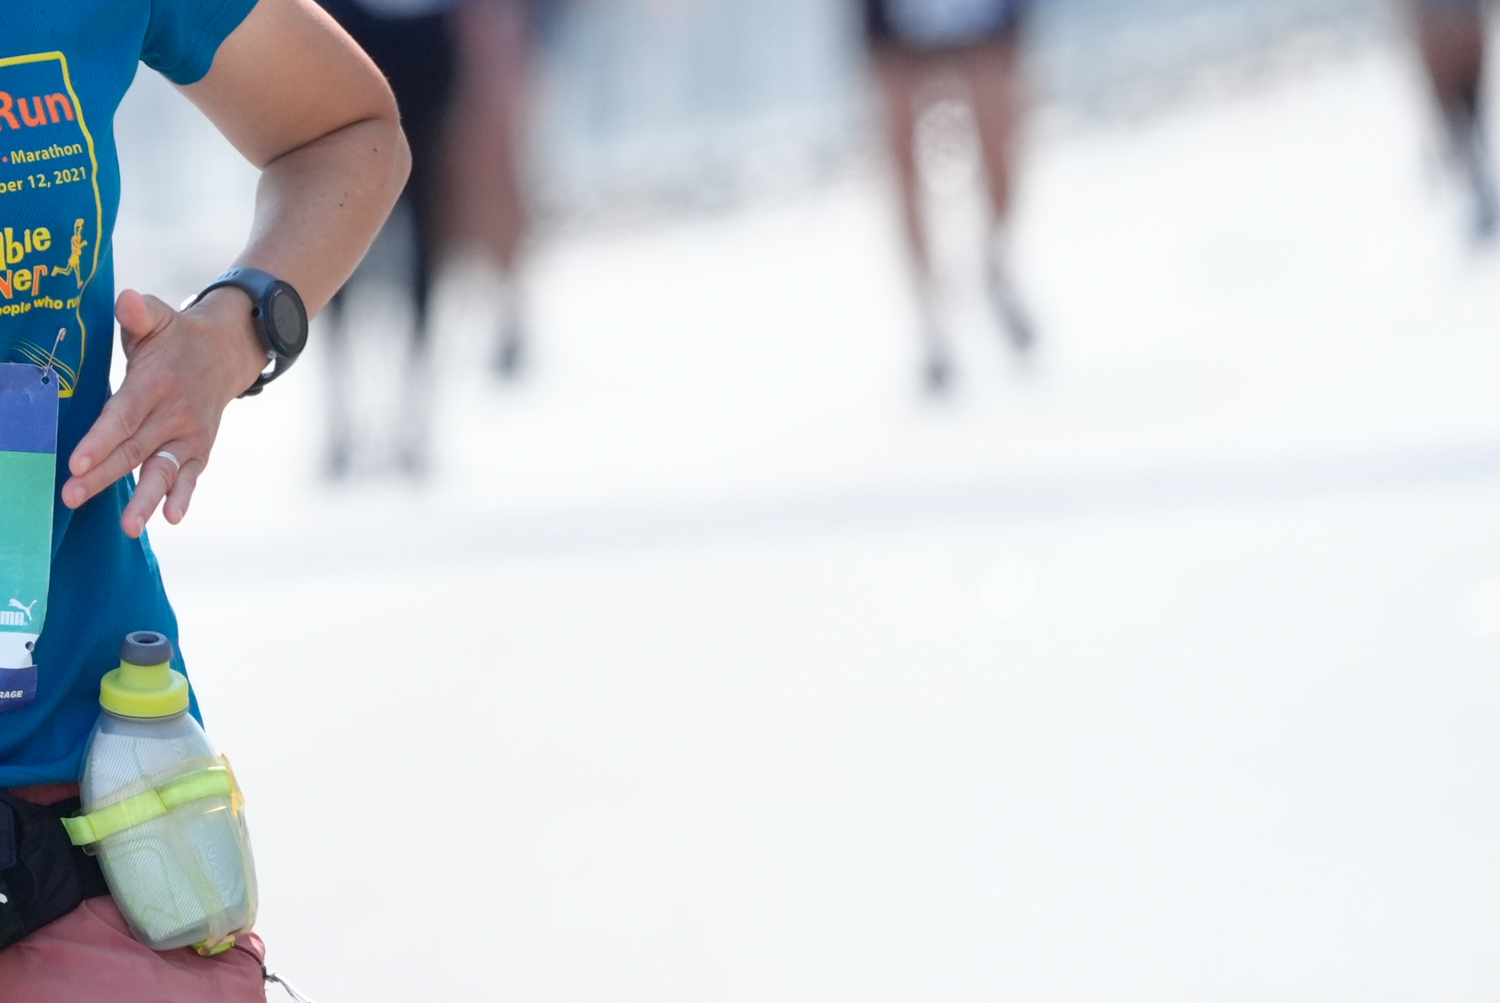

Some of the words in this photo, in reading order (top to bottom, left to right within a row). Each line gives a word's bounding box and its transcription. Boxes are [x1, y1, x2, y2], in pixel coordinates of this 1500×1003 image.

[11, 140, 83, 165] Marathon
[27, 173, 52, 192] 12,
[54, 165, 87, 186] 2021
[33, 295, 63, 310] who
